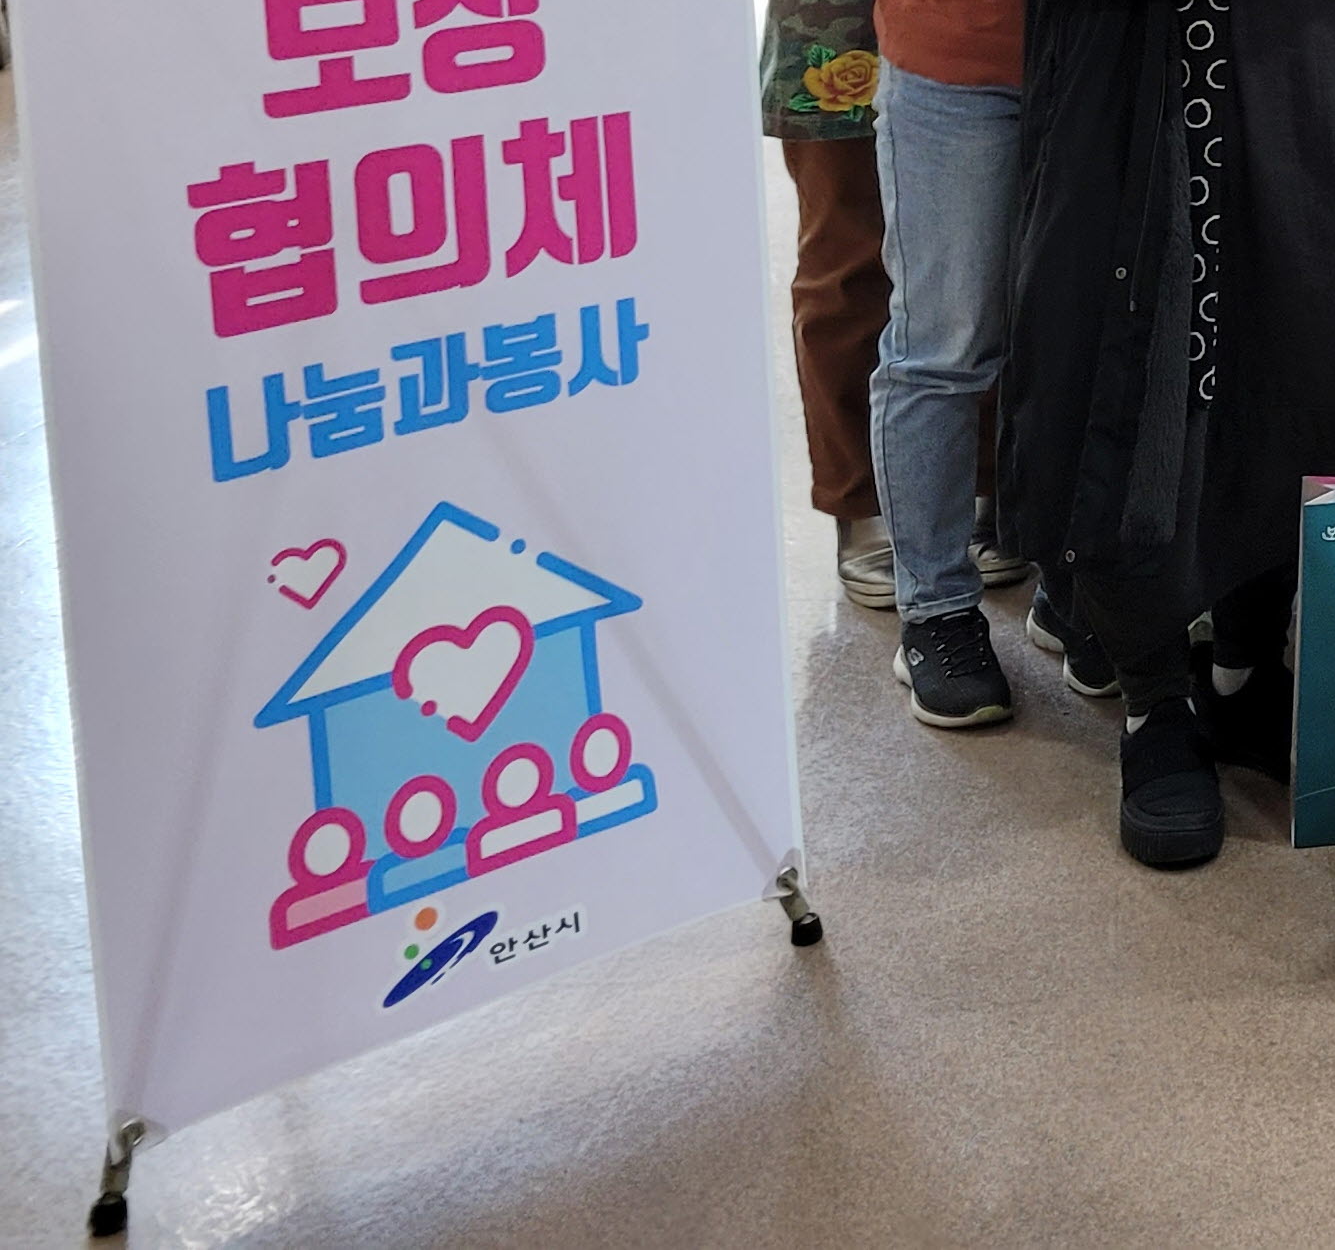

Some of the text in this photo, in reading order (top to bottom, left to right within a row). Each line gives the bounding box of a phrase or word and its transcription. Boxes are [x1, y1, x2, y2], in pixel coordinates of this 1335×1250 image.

[186, 111, 640, 338] 협의체
[205, 297, 650, 483] 나눔과봉사
[489, 911, 581, 965] 안산시
